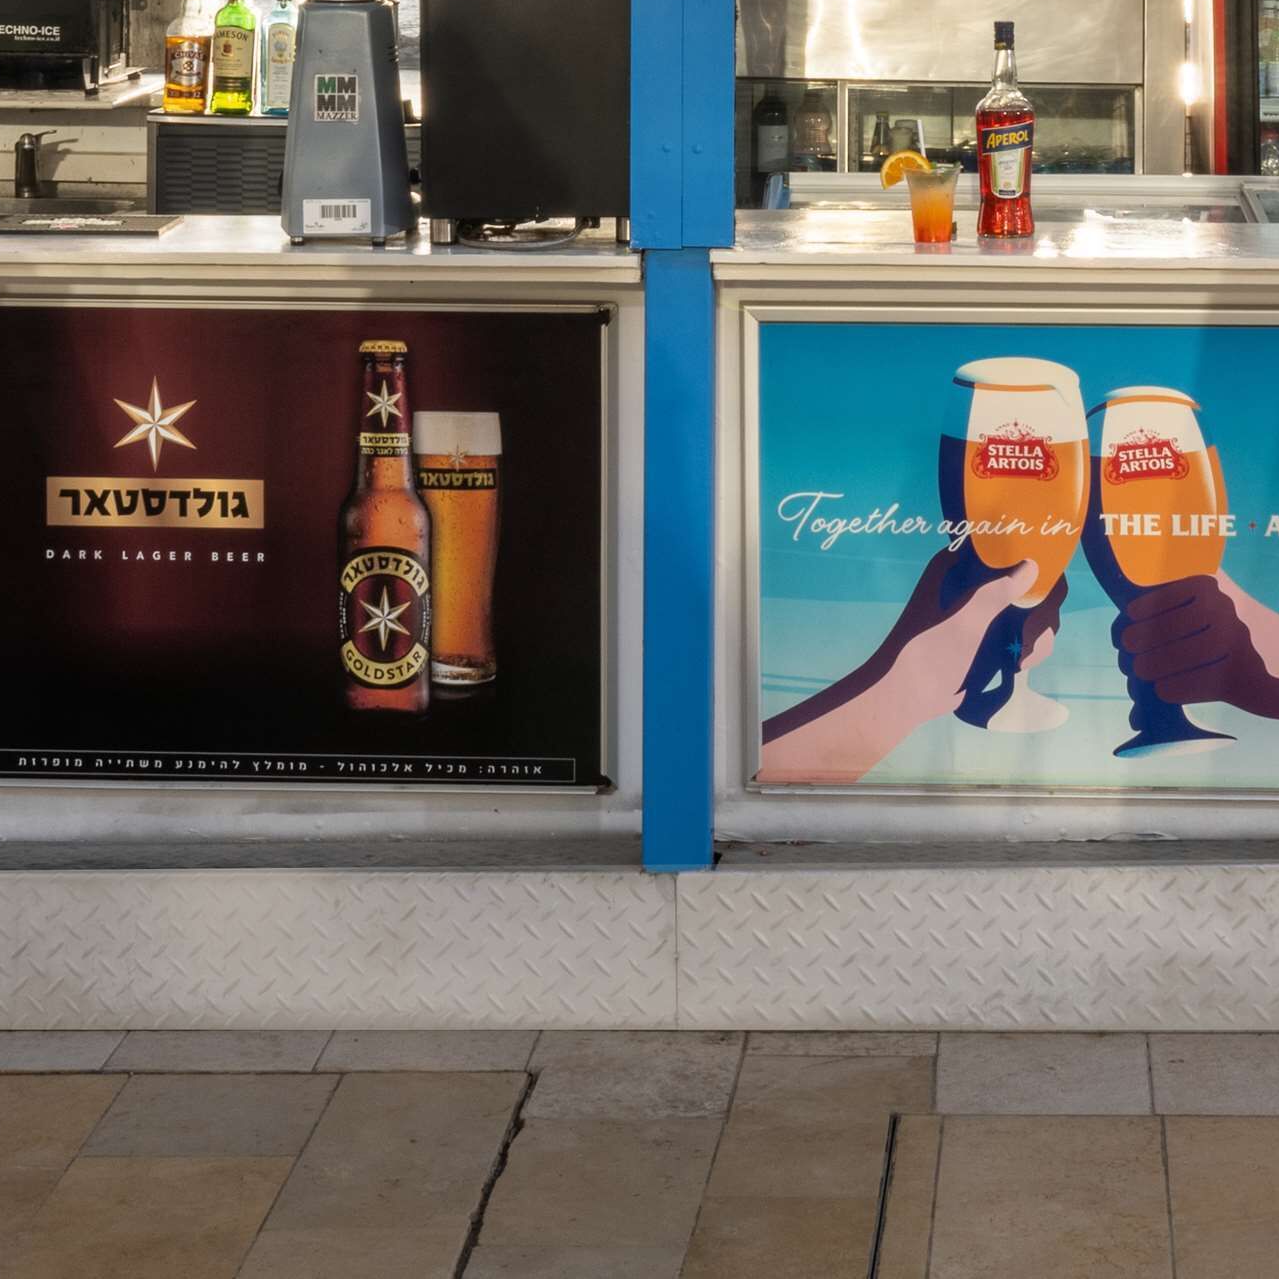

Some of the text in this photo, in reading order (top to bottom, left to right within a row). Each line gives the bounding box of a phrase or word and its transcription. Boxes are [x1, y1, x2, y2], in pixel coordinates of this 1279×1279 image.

[317, 111, 358, 120] MAZZER
[986, 129, 1029, 149] APEROL
[987, 444, 1044, 458] STELLA
[1119, 447, 1172, 462] STELLA
[987, 457, 1044, 471] ARTOIS
[1119, 458, 1175, 474] ARTOIS
[421, 471, 495, 487] גולדסטאר
[59, 487, 251, 519] גולדסטאר
[777, 491, 932, 551] Together
[937, 514, 1035, 552] again
[1040, 514, 1081, 536] in
[1099, 514, 1163, 537] THE
[1171, 514, 1237, 537] LIFE
[45, 549, 265, 563] DARK LAGER BEER
[344, 555, 426, 590] גולדסטאר
[346, 649, 422, 681] GOLDSTAR
[18, 756, 83, 768] מופרזת
[95, 758, 163, 769] משתייה
[175, 759, 241, 770] להימנע
[252, 760, 308, 772] מומלץ
[337, 761, 414, 773] אלכוהול
[424, 762, 468, 774] מכיל
[479, 764, 544, 775] אזהרה:
